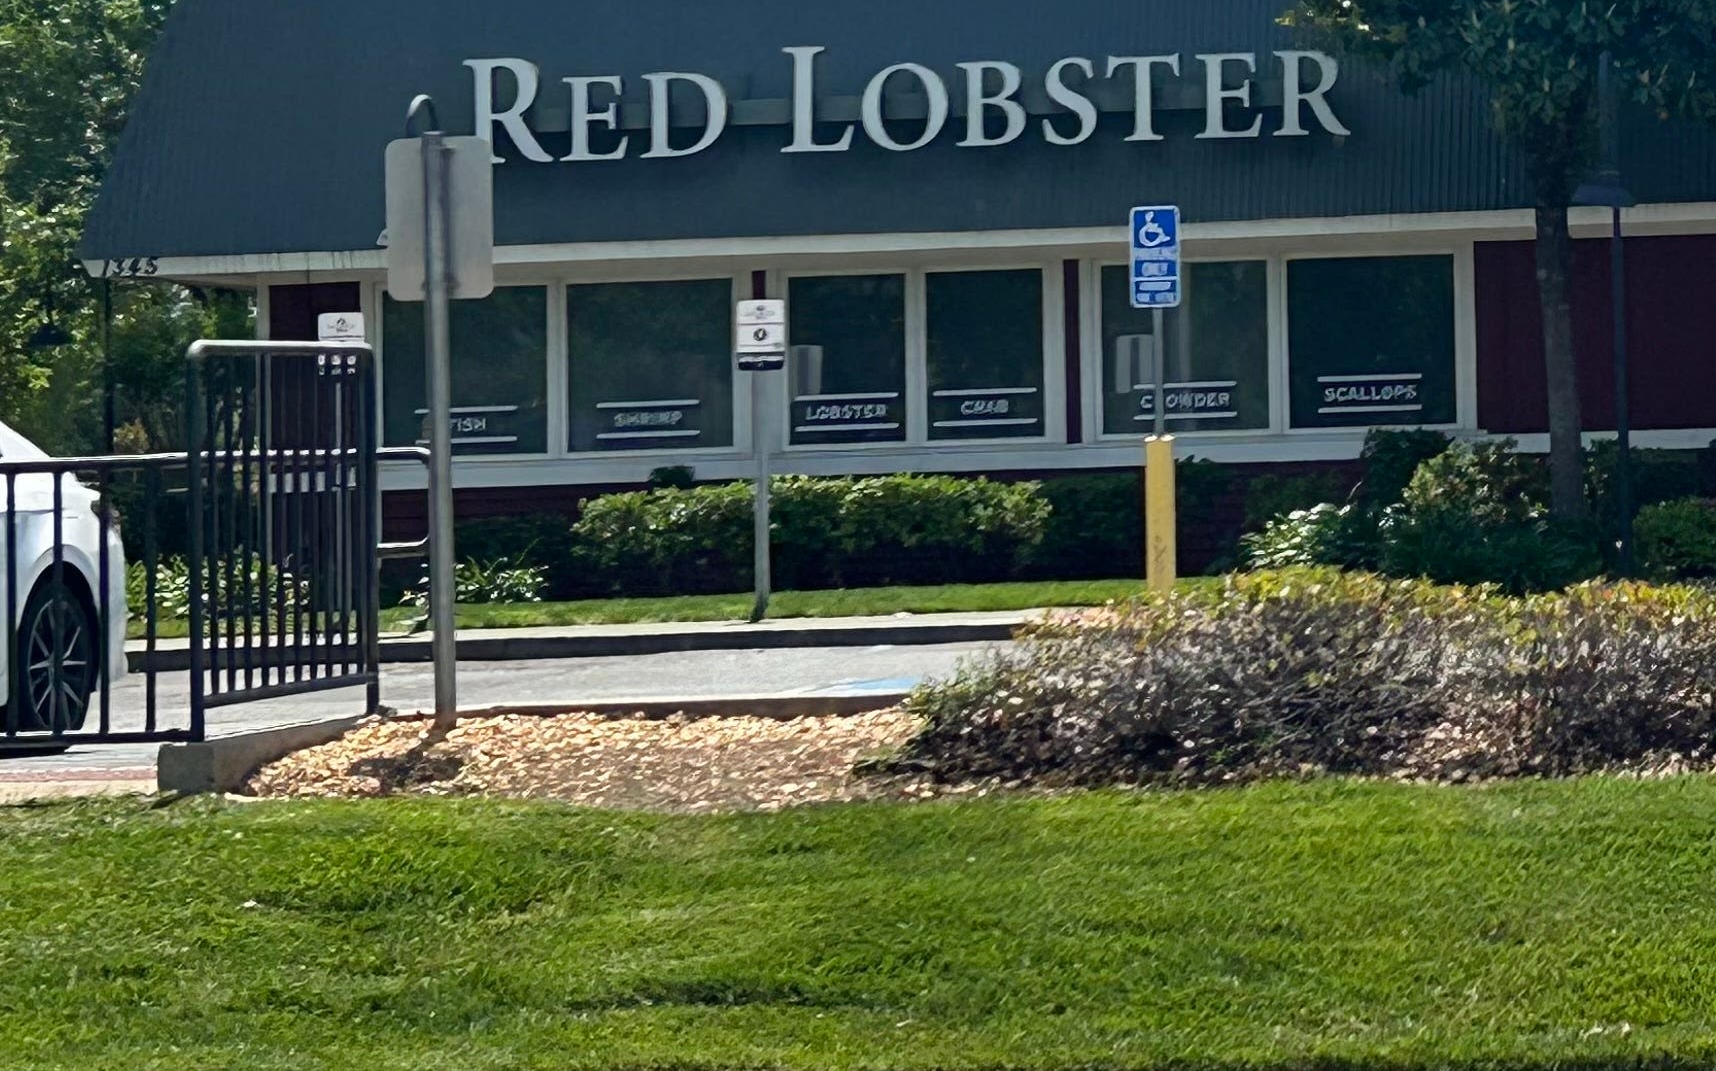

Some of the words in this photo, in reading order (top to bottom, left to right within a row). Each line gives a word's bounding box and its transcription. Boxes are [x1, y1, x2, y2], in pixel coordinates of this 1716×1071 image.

[462, 57, 728, 163] RED
[780, 46, 1352, 152] LOBSTER
[1139, 392, 1231, 410] COWDER
[1323, 384, 1418, 403] SCALLOPS
